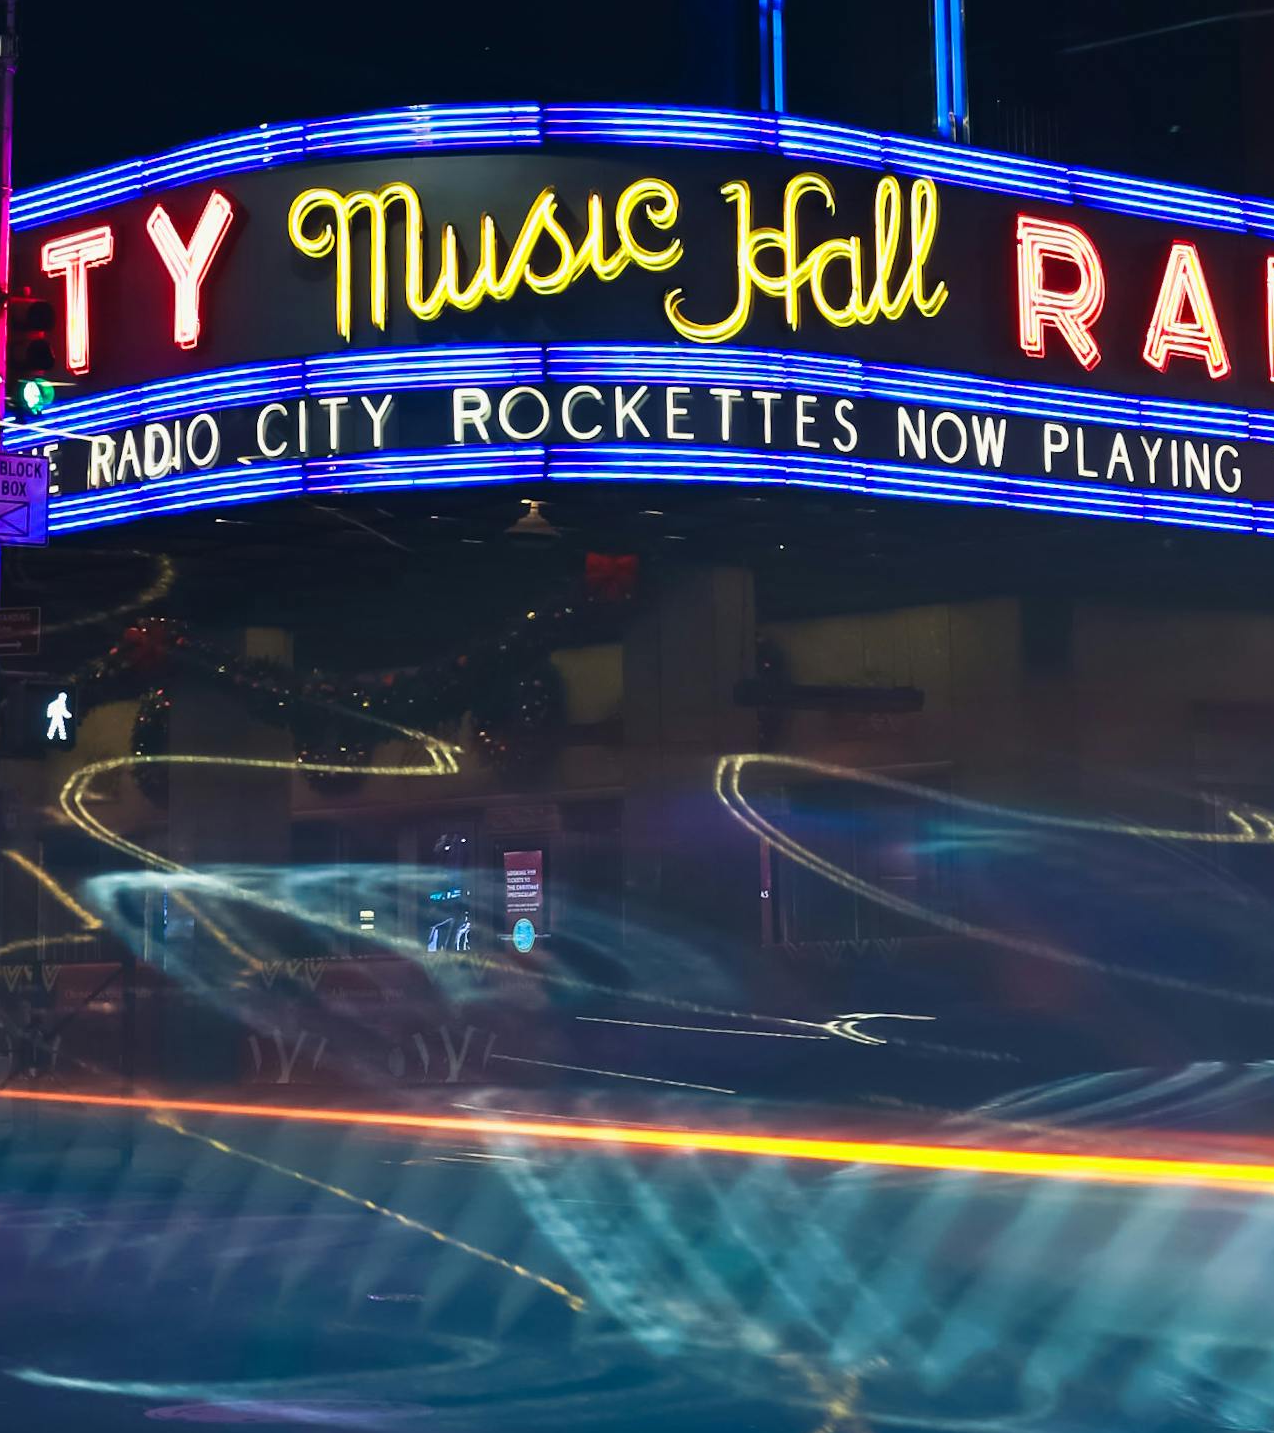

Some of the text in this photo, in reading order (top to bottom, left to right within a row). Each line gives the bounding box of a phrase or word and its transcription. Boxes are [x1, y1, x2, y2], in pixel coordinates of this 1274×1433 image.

[287, 178, 685, 343] Music
[664, 171, 950, 344] Hall
[0, 460, 43, 479] BLOCK
[88, 413, 219, 489] RADIO
[255, 392, 395, 460] CITY
[452, 384, 860, 455] ROCKETTES
[896, 405, 1007, 471] NOW
[1042, 423, 1244, 496] PLAYING
[1, 480, 27, 497] BOX
